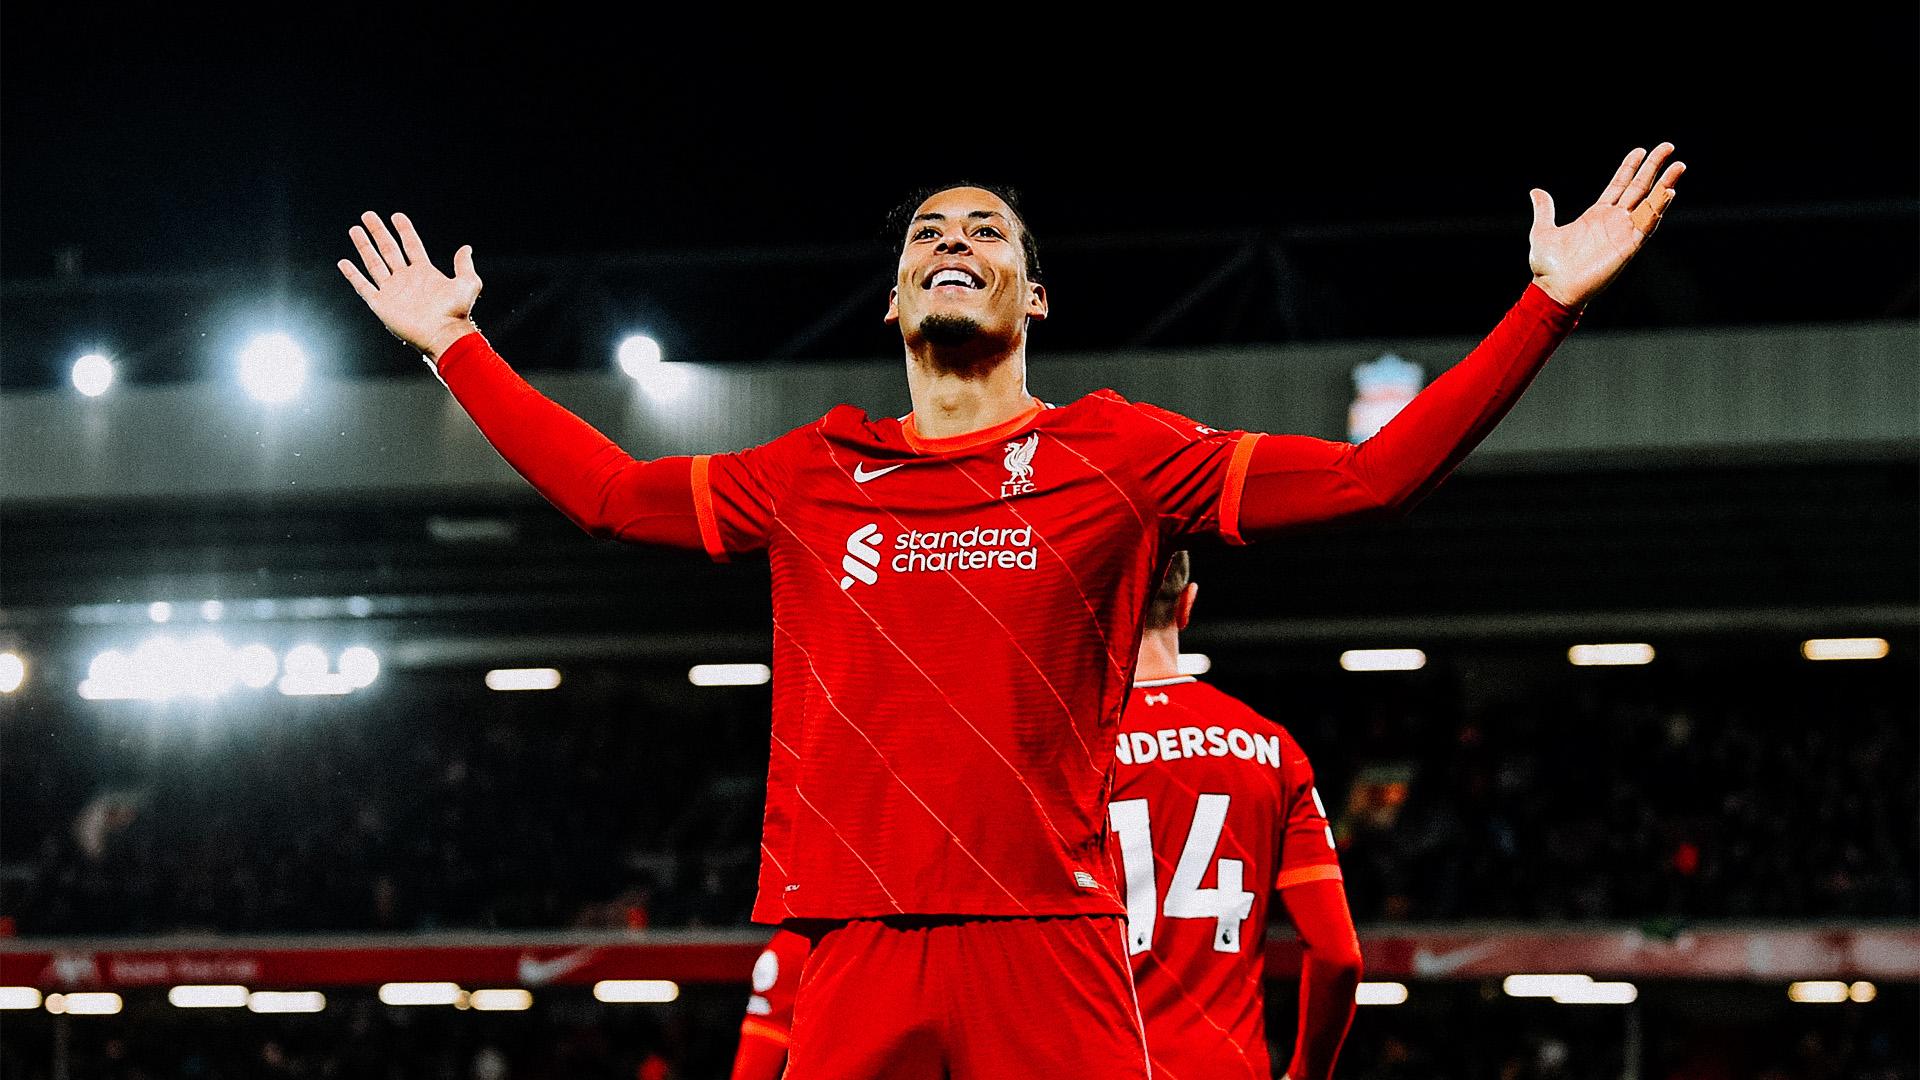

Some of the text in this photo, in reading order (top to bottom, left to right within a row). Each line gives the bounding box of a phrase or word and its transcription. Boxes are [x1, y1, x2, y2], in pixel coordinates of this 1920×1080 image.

[894, 525, 1032, 550] standard
[891, 547, 1038, 573] chartered
[1107, 793, 1255, 957] 14
